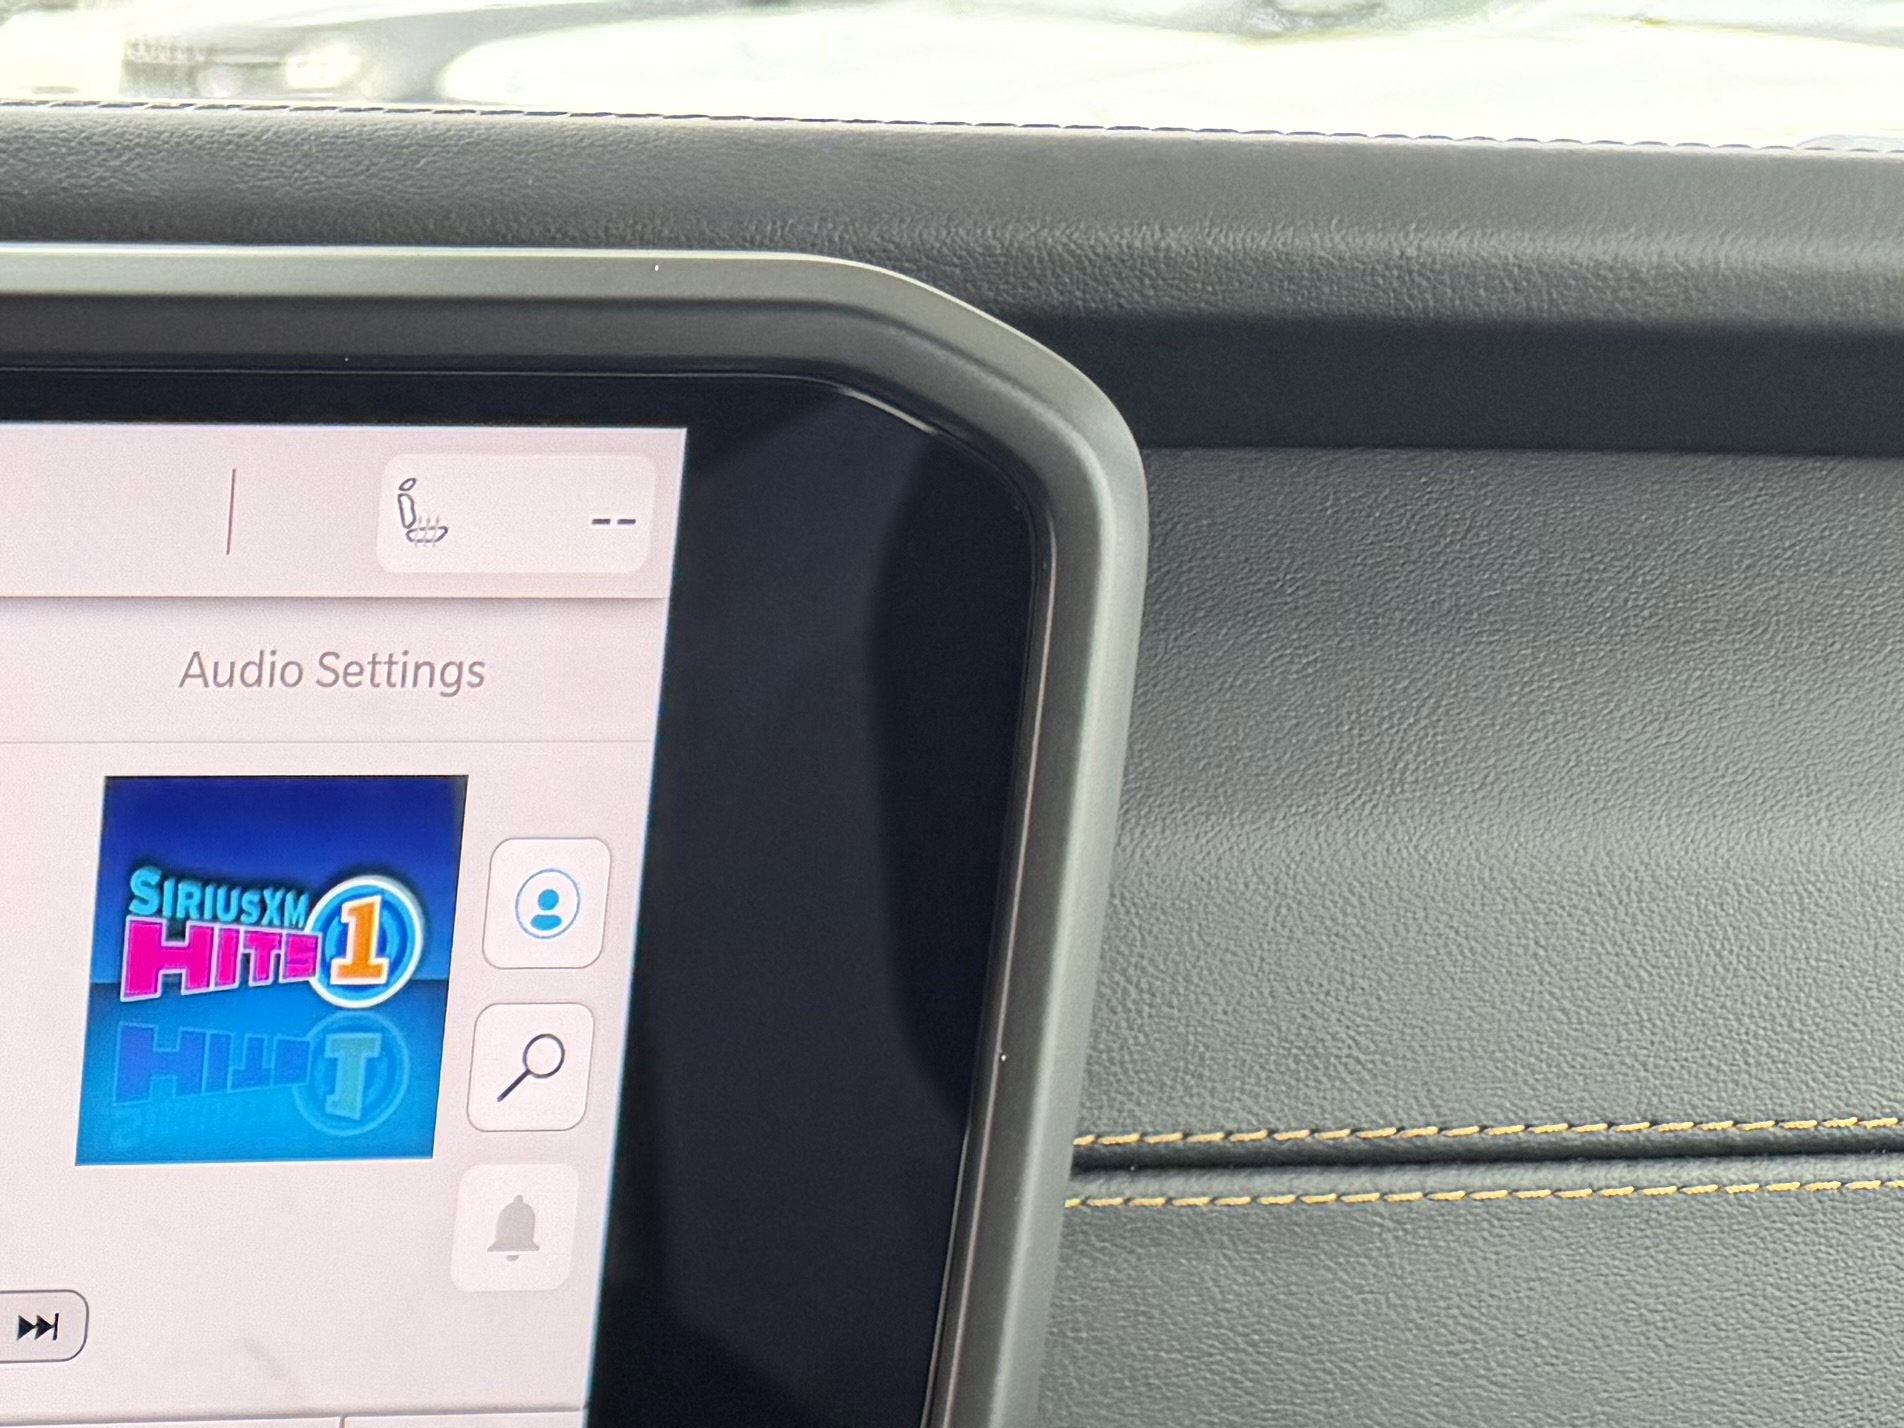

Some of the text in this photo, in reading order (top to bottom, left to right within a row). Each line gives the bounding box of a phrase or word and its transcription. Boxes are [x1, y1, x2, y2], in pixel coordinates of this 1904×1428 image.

[179, 649, 486, 698] Audio Settings
[120, 894, 390, 1002] HITS 1
